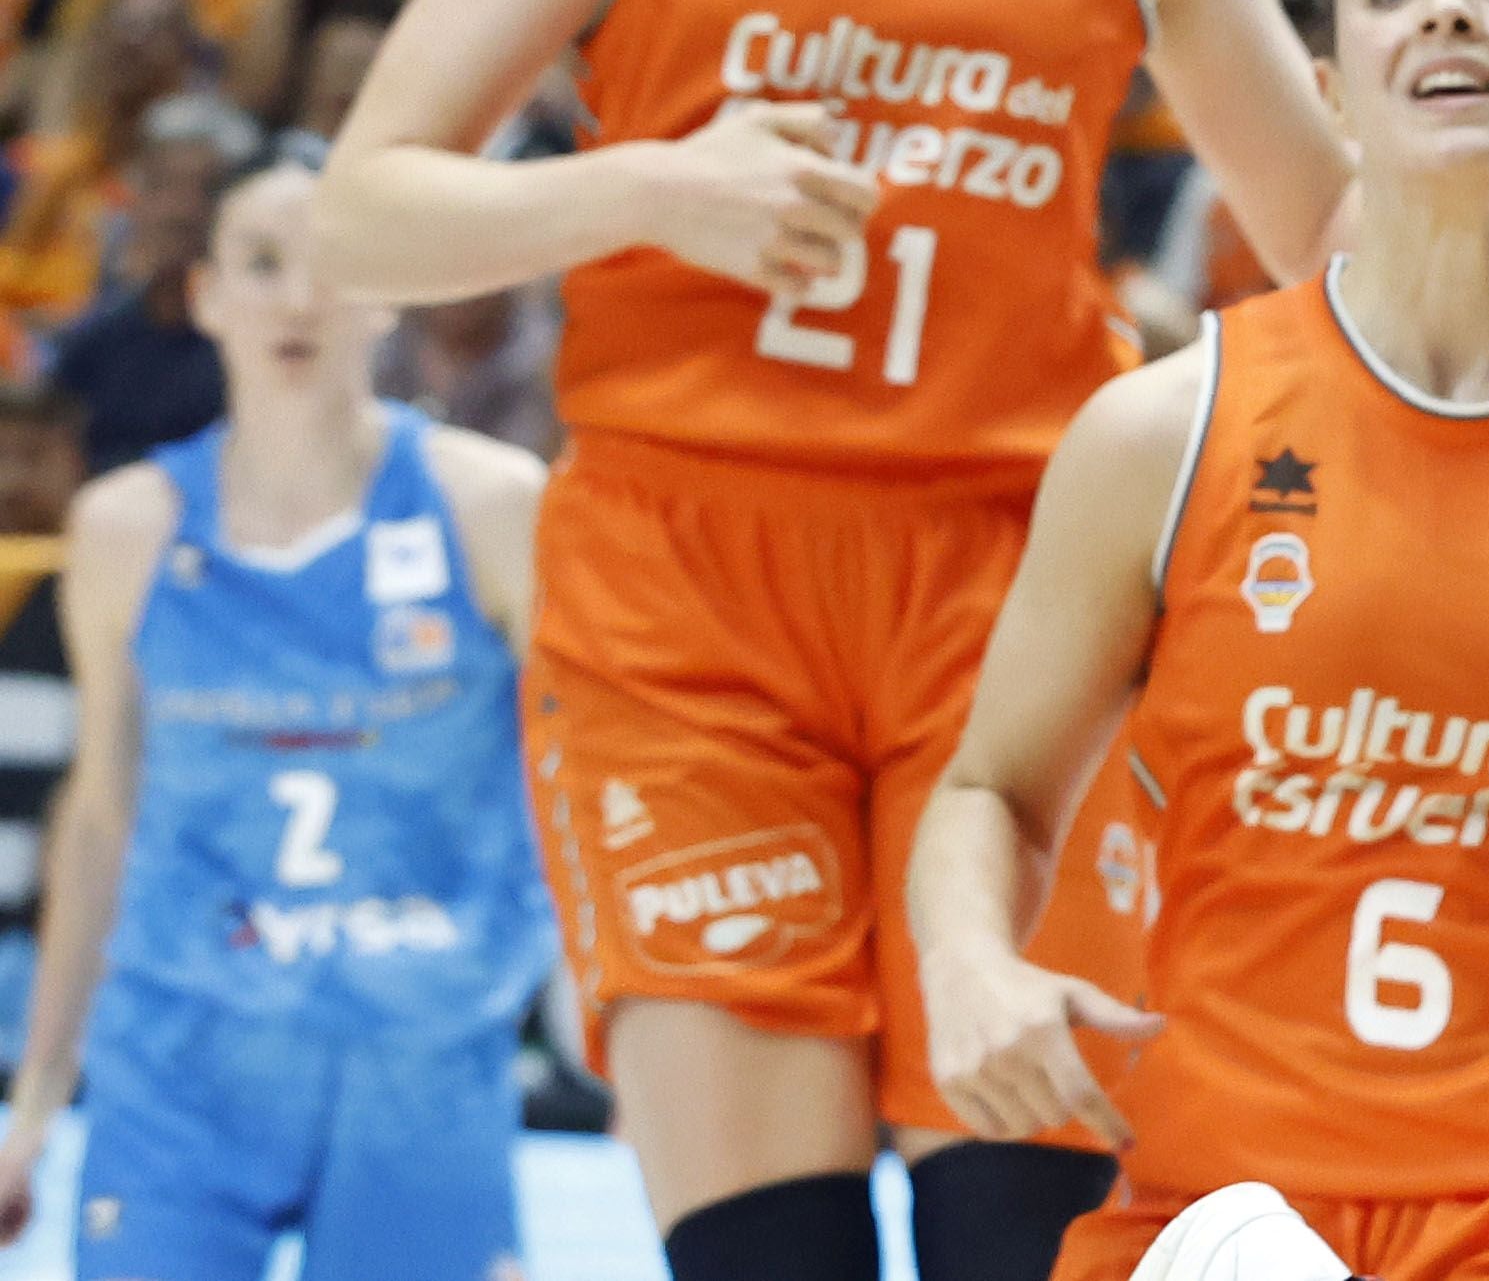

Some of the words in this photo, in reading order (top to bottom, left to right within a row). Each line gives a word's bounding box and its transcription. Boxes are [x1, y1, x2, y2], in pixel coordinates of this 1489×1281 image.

[721, 11, 1012, 113] Cultura
[756, 224, 938, 387] 21
[267, 769, 345, 887] 2
[629, 851, 823, 935] PULEVA
[1342, 877, 1453, 1051] 6
